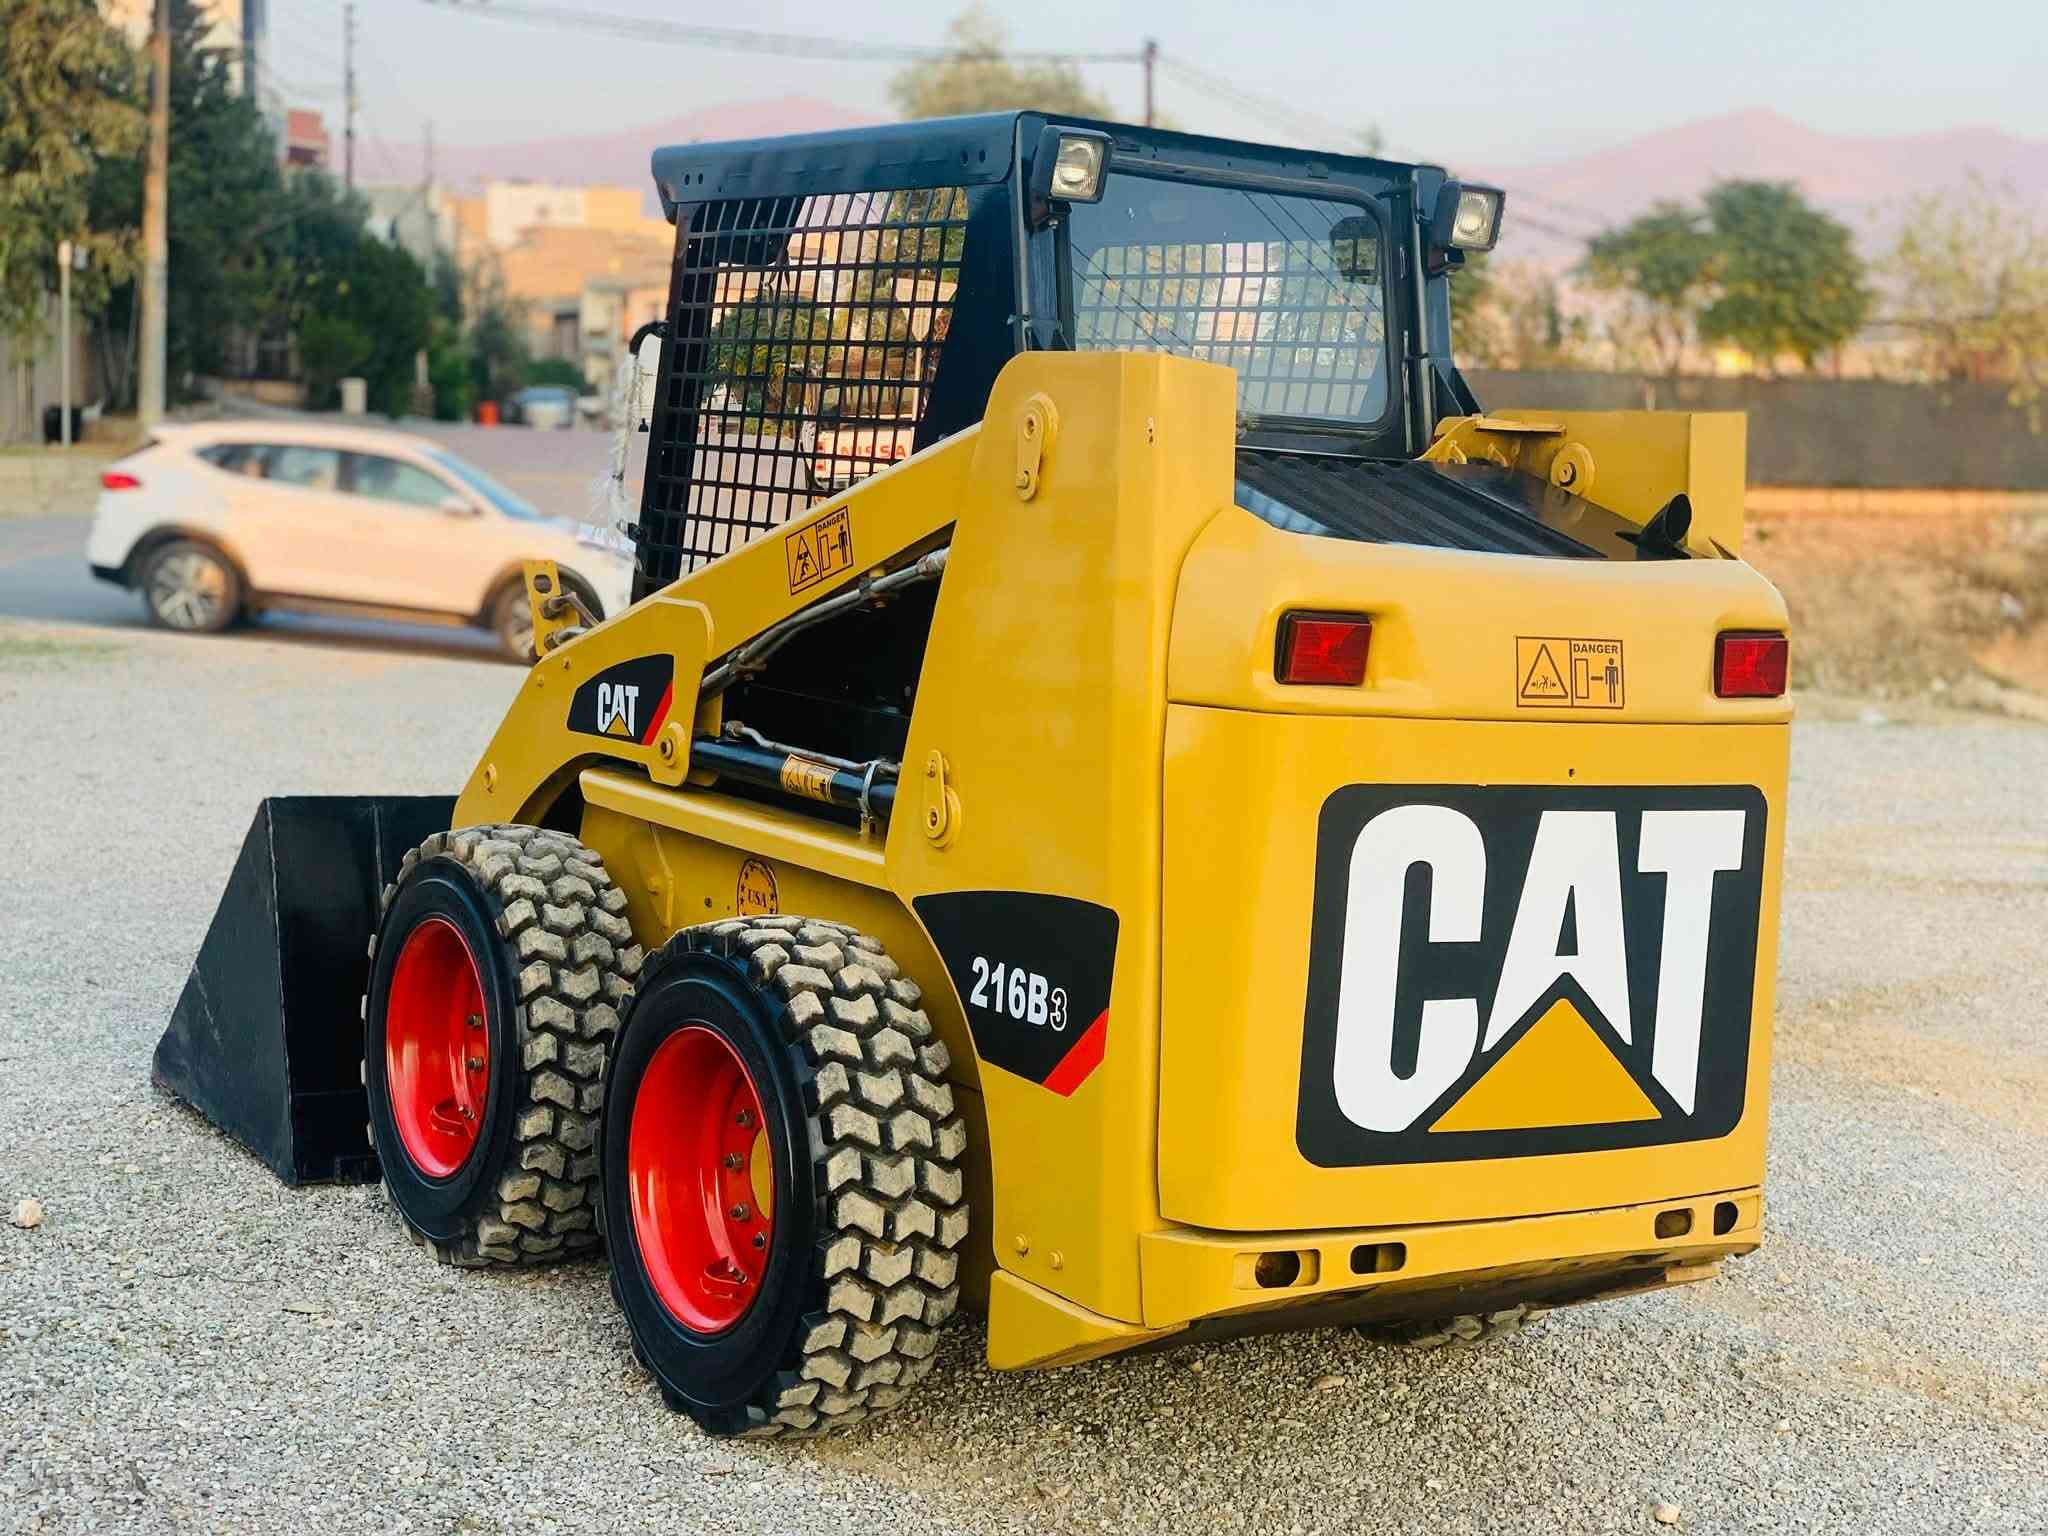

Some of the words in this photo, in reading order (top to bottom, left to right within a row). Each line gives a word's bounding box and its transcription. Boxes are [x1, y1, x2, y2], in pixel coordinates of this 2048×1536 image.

[817, 512, 847, 532] DANGER
[1573, 643, 1619, 654] DANGER
[597, 682, 640, 737] CAT
[747, 888, 767, 908] USA
[1333, 804, 1746, 1133] CAT
